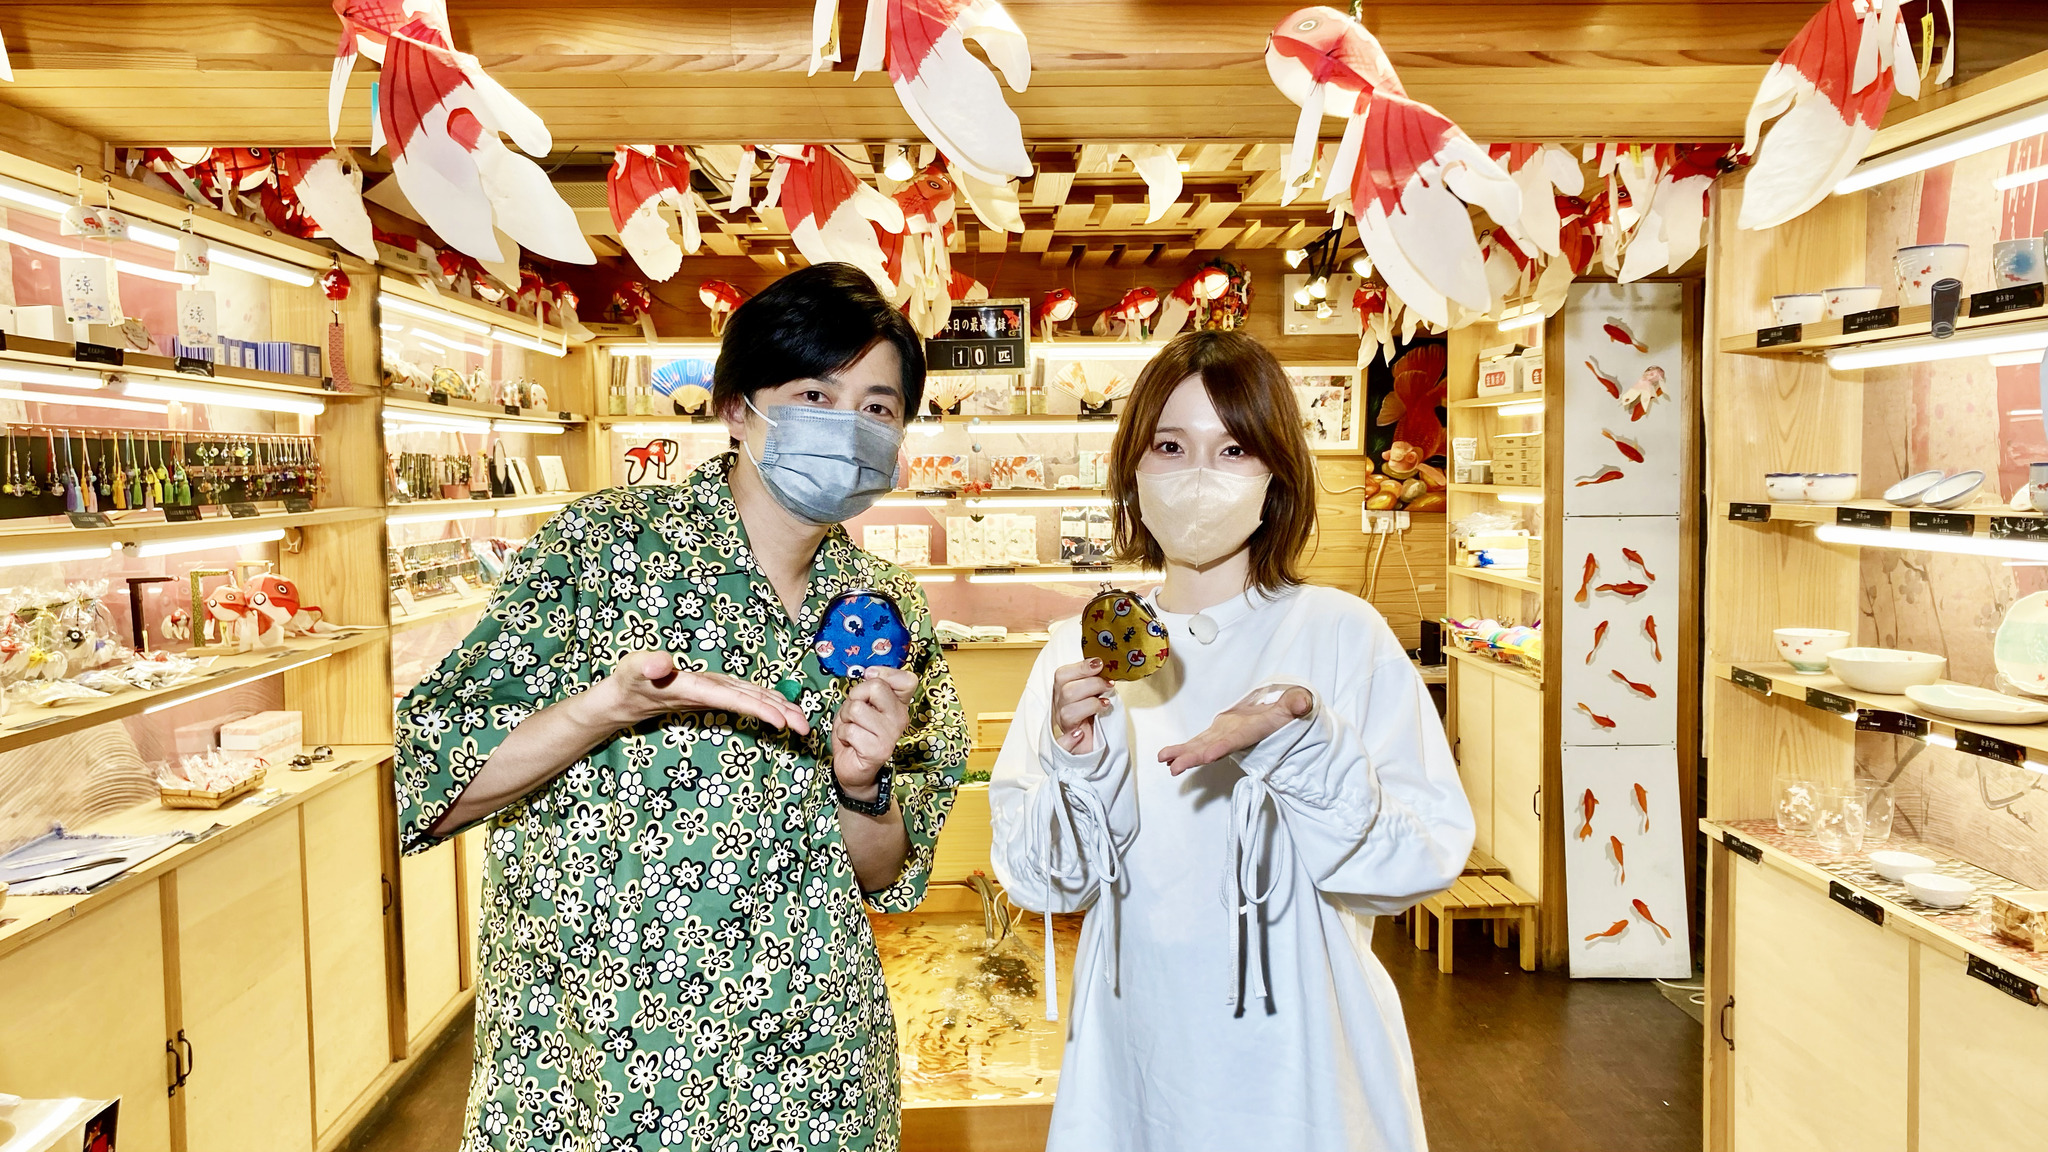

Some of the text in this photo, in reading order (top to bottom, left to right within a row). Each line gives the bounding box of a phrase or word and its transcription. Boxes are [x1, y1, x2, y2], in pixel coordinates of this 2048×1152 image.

[75, 275, 94, 295] 涼
[189, 306, 205, 324] 涼
[957, 348, 1012, 365] 10 匹
